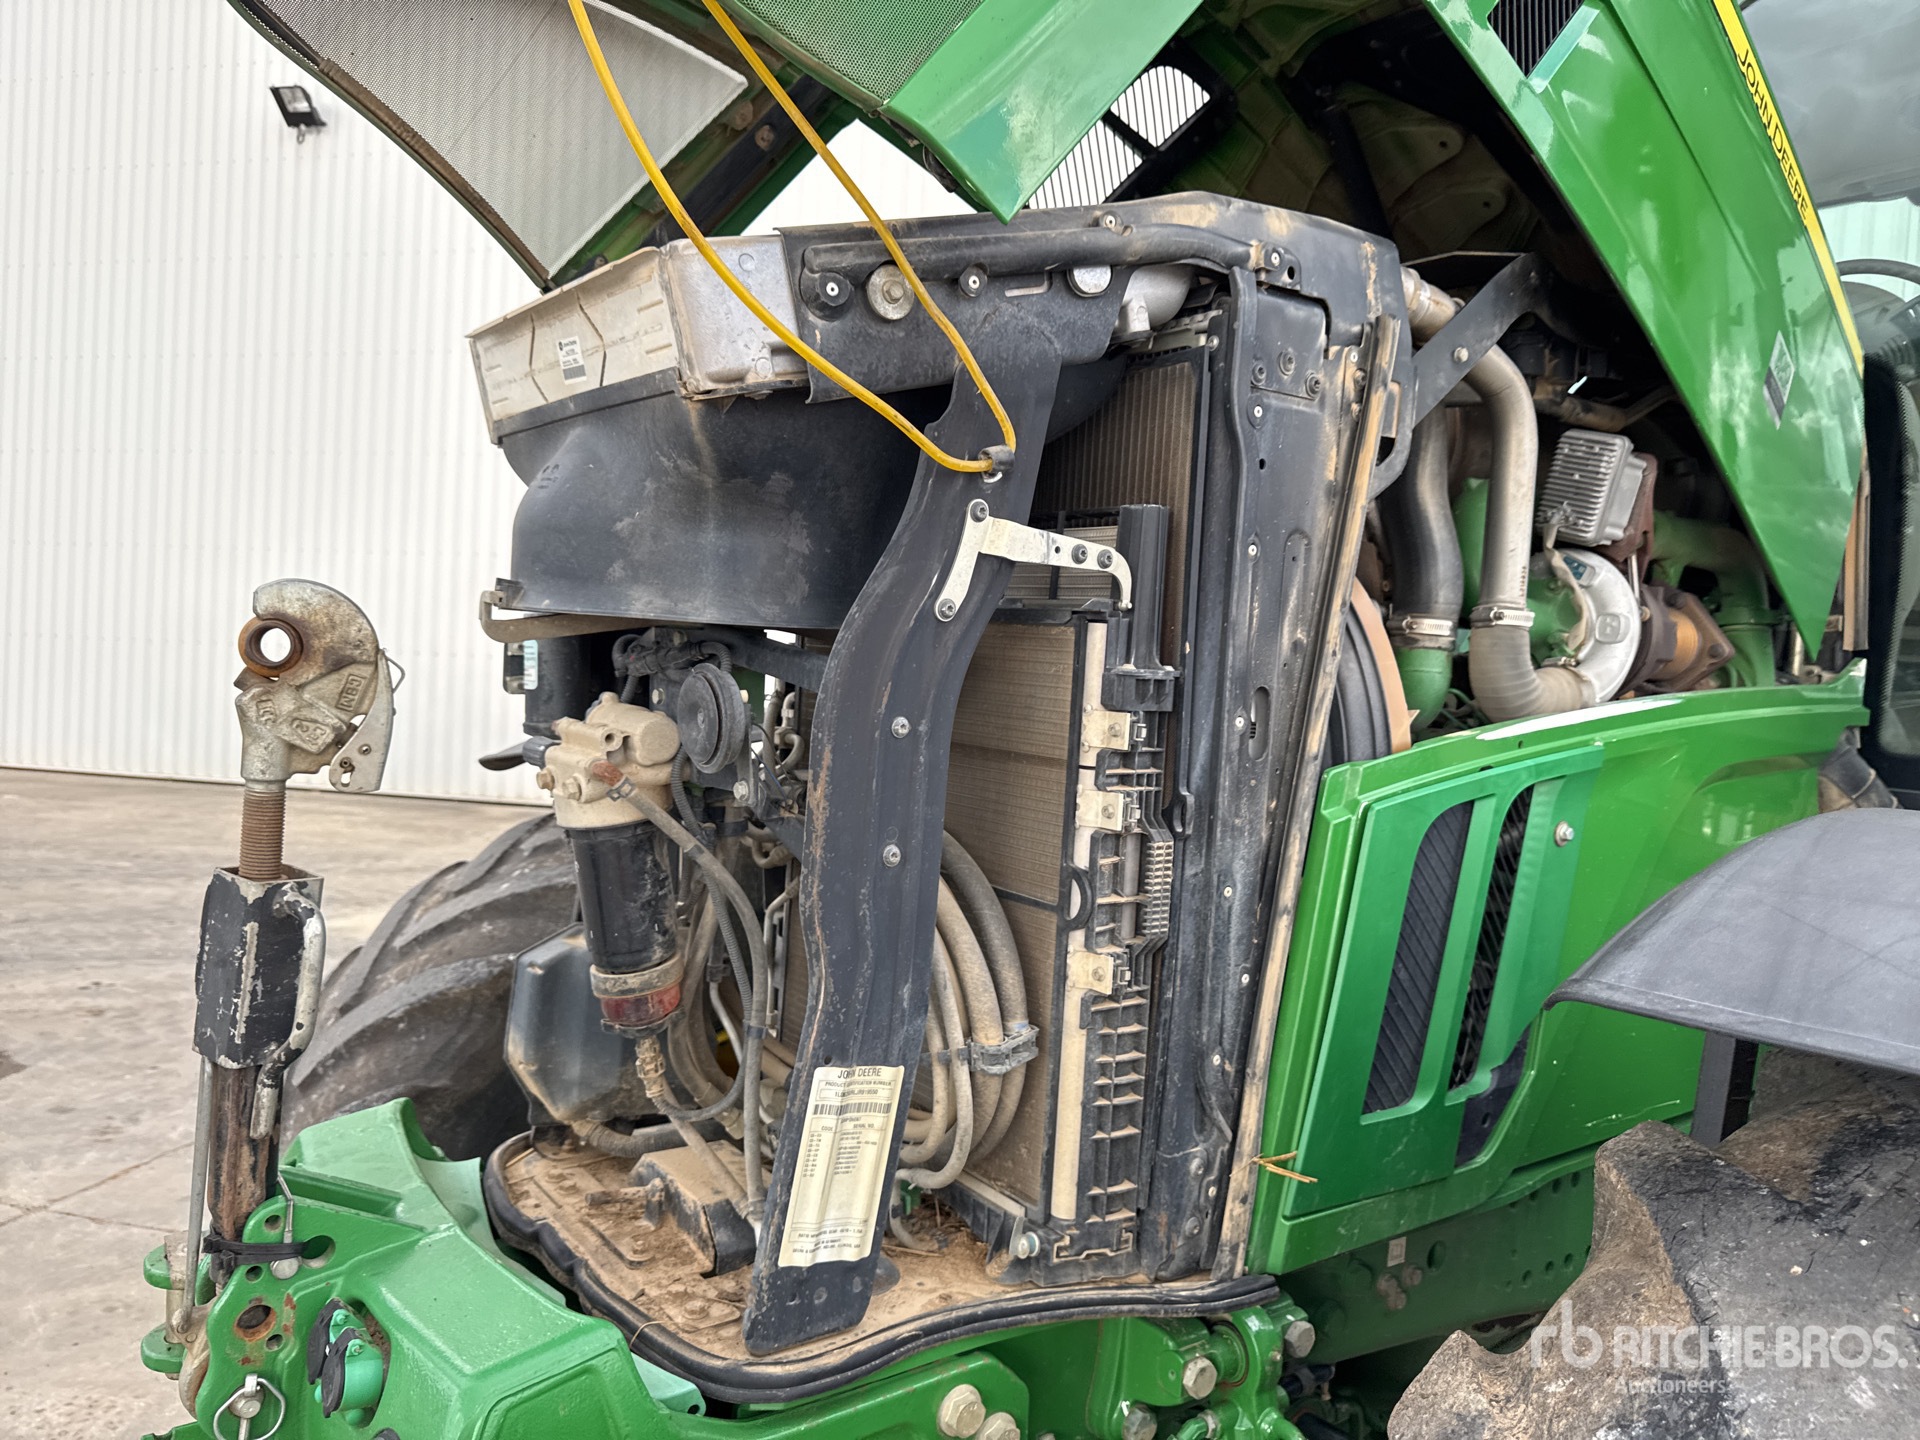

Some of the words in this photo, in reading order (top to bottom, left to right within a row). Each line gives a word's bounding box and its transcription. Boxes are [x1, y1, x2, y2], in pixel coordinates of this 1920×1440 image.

[1737, 48, 1773, 131] JOHN
[1772, 122, 1809, 220] DEERE
[340, 678, 362, 708] CBM
[837, 1068, 856, 1079] JOHN
[857, 1067, 882, 1077] DEERE
